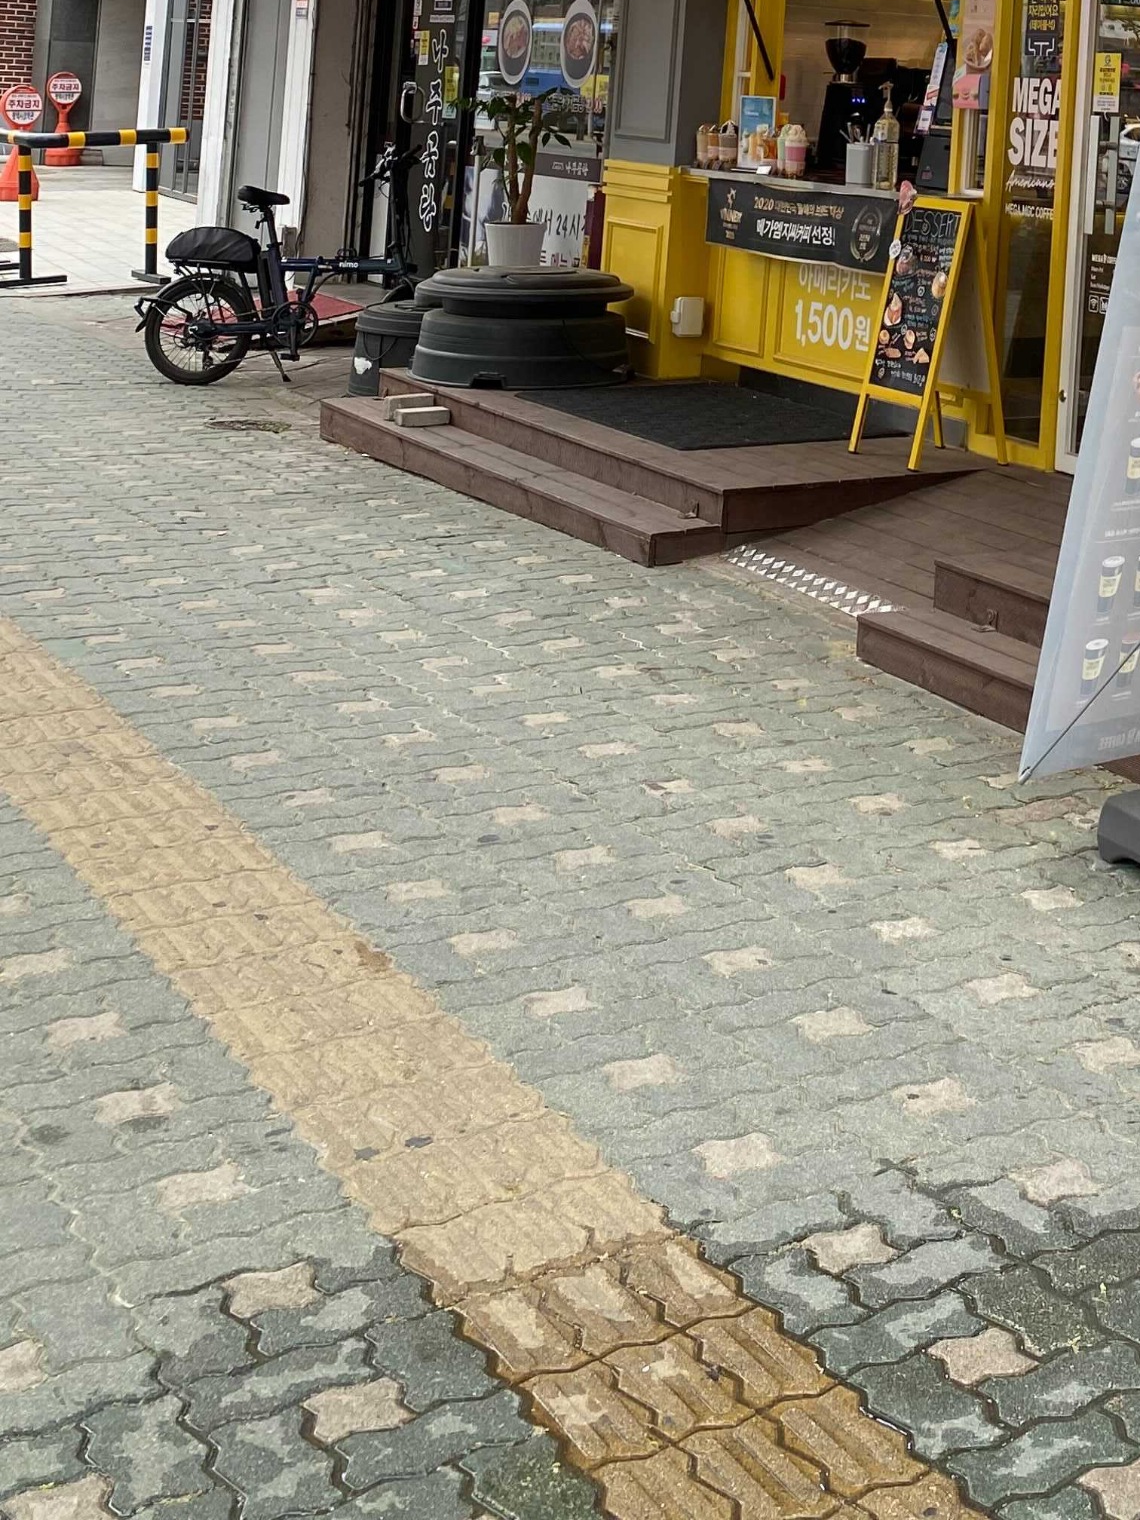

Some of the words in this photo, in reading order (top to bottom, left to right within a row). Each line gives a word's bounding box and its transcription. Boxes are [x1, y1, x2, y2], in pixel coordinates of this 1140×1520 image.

[8, 100, 40, 108] 주차금지
[754, 197, 774, 211] 2020
[812, 226, 836, 246] 선정!
[904, 210, 961, 238] DESSERT
[800, 265, 872, 301] 아메리카노
[795, 299, 870, 352] 1,500원
